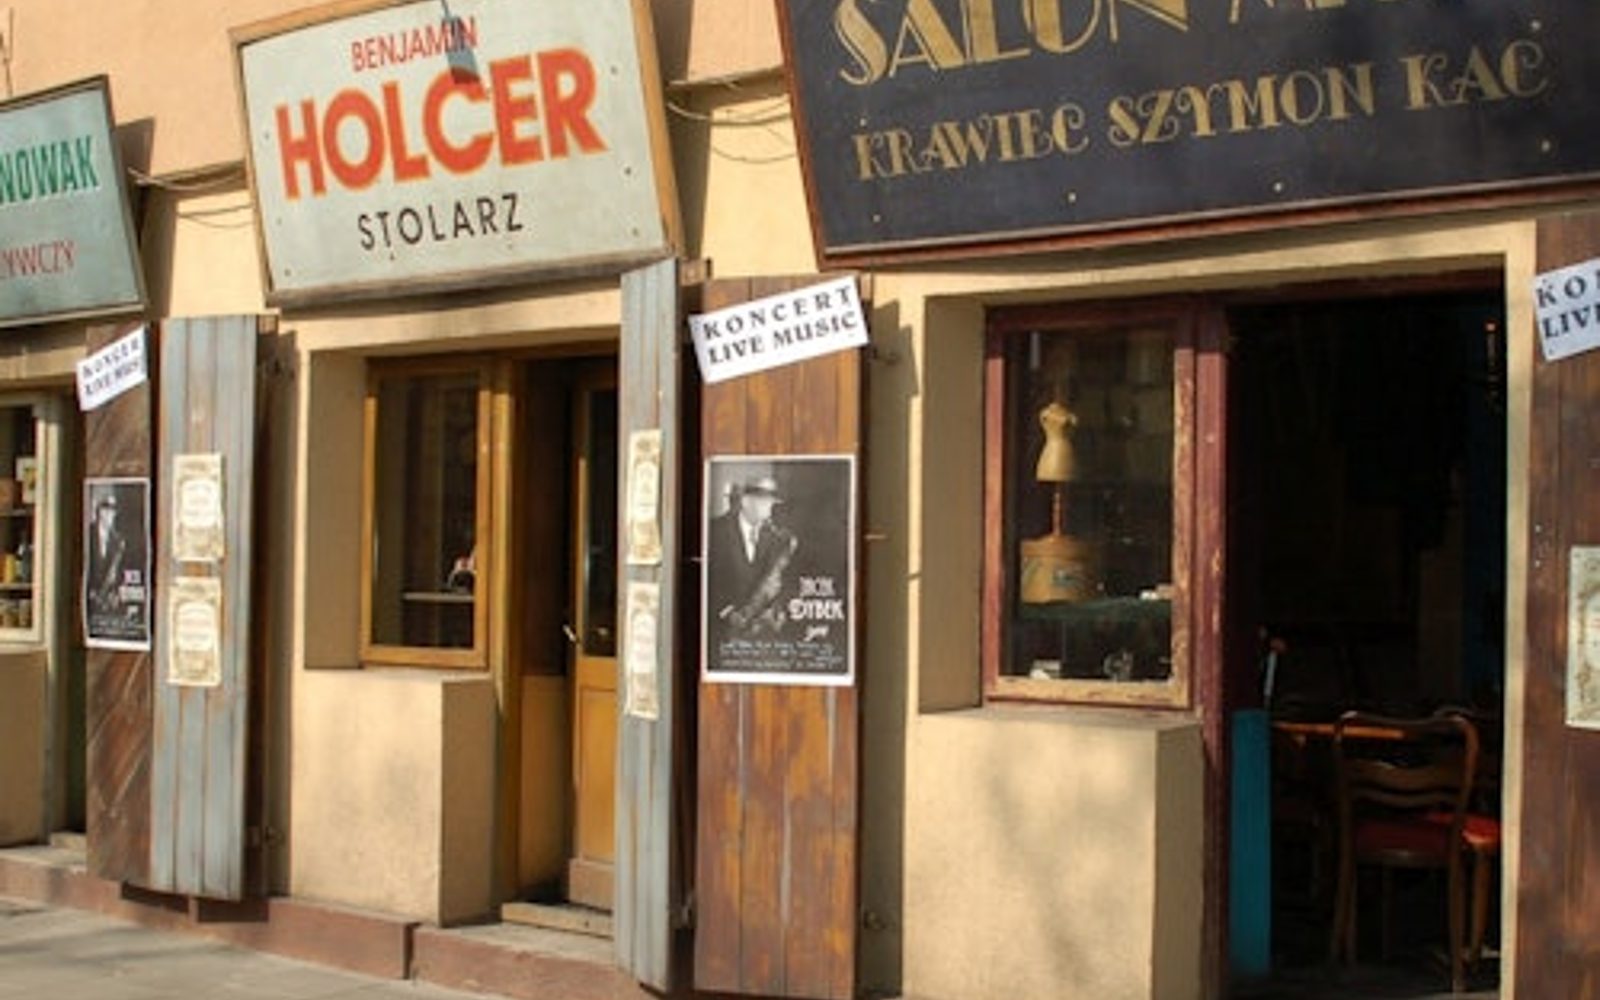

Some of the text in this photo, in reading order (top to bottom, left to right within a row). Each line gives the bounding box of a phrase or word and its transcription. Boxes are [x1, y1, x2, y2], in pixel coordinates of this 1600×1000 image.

[351, 16, 478, 72] BENJAMIN
[275, 47, 609, 200] HOLCER
[852, 39, 1549, 180] KRAWIEC SZYMON KAC
[0, 134, 99, 205] NOWAK
[357, 192, 524, 251] STOLARZ
[0, 240, 75, 278] YWCZY
[703, 285, 851, 341] KONCERT
[1536, 268, 1600, 308] KO
[709, 311, 857, 365] LIVE MUSIC
